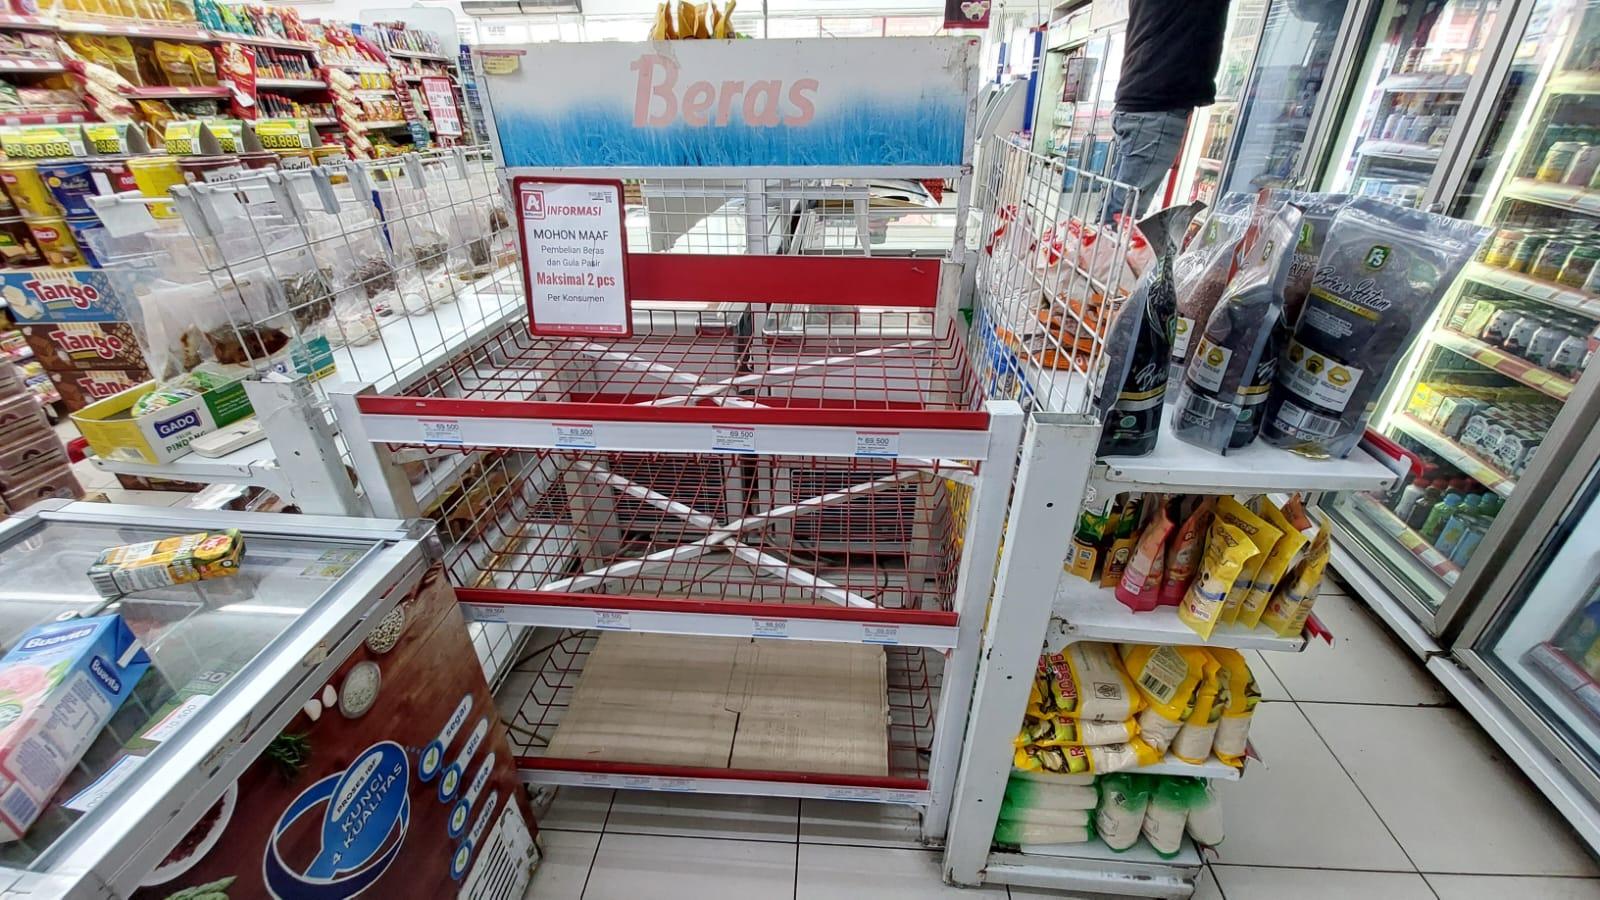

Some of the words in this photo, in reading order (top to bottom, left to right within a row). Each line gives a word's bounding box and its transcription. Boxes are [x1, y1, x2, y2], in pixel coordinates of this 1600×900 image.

[630, 53, 819, 129] Beras
[547, 205, 602, 217] INFORMASI
[533, 229, 576, 241] MOHON
[578, 230, 609, 241] MAAF
[541, 245, 581, 255] Pembelian
[583, 246, 605, 255] Beras
[546, 258, 561, 267] dan
[562, 258, 579, 267] Gula
[581, 259, 600, 268] Pasir
[536, 272, 585, 287] Maksimal
[587, 274, 595, 287] 2
[597, 275, 616, 288] pcs
[23, 281, 99, 309] Tango
[547, 293, 561, 302] Per
[562, 294, 605, 303] Konsumen
[49, 331, 122, 359] Tango
[160, 415, 195, 435] GADO
[24, 628, 93, 649] Buavita
[91, 659, 121, 692] Buavita
[446, 704, 469, 739] segar
[465, 733, 481, 757] gizi
[471, 765, 491, 793] rasa
[336, 776, 366, 814] PROSES
[341, 773, 386, 832] KUNCI
[331, 851, 343, 865] 4
[343, 763, 403, 848] KUALITAS
[472, 799, 496, 838] bersih
